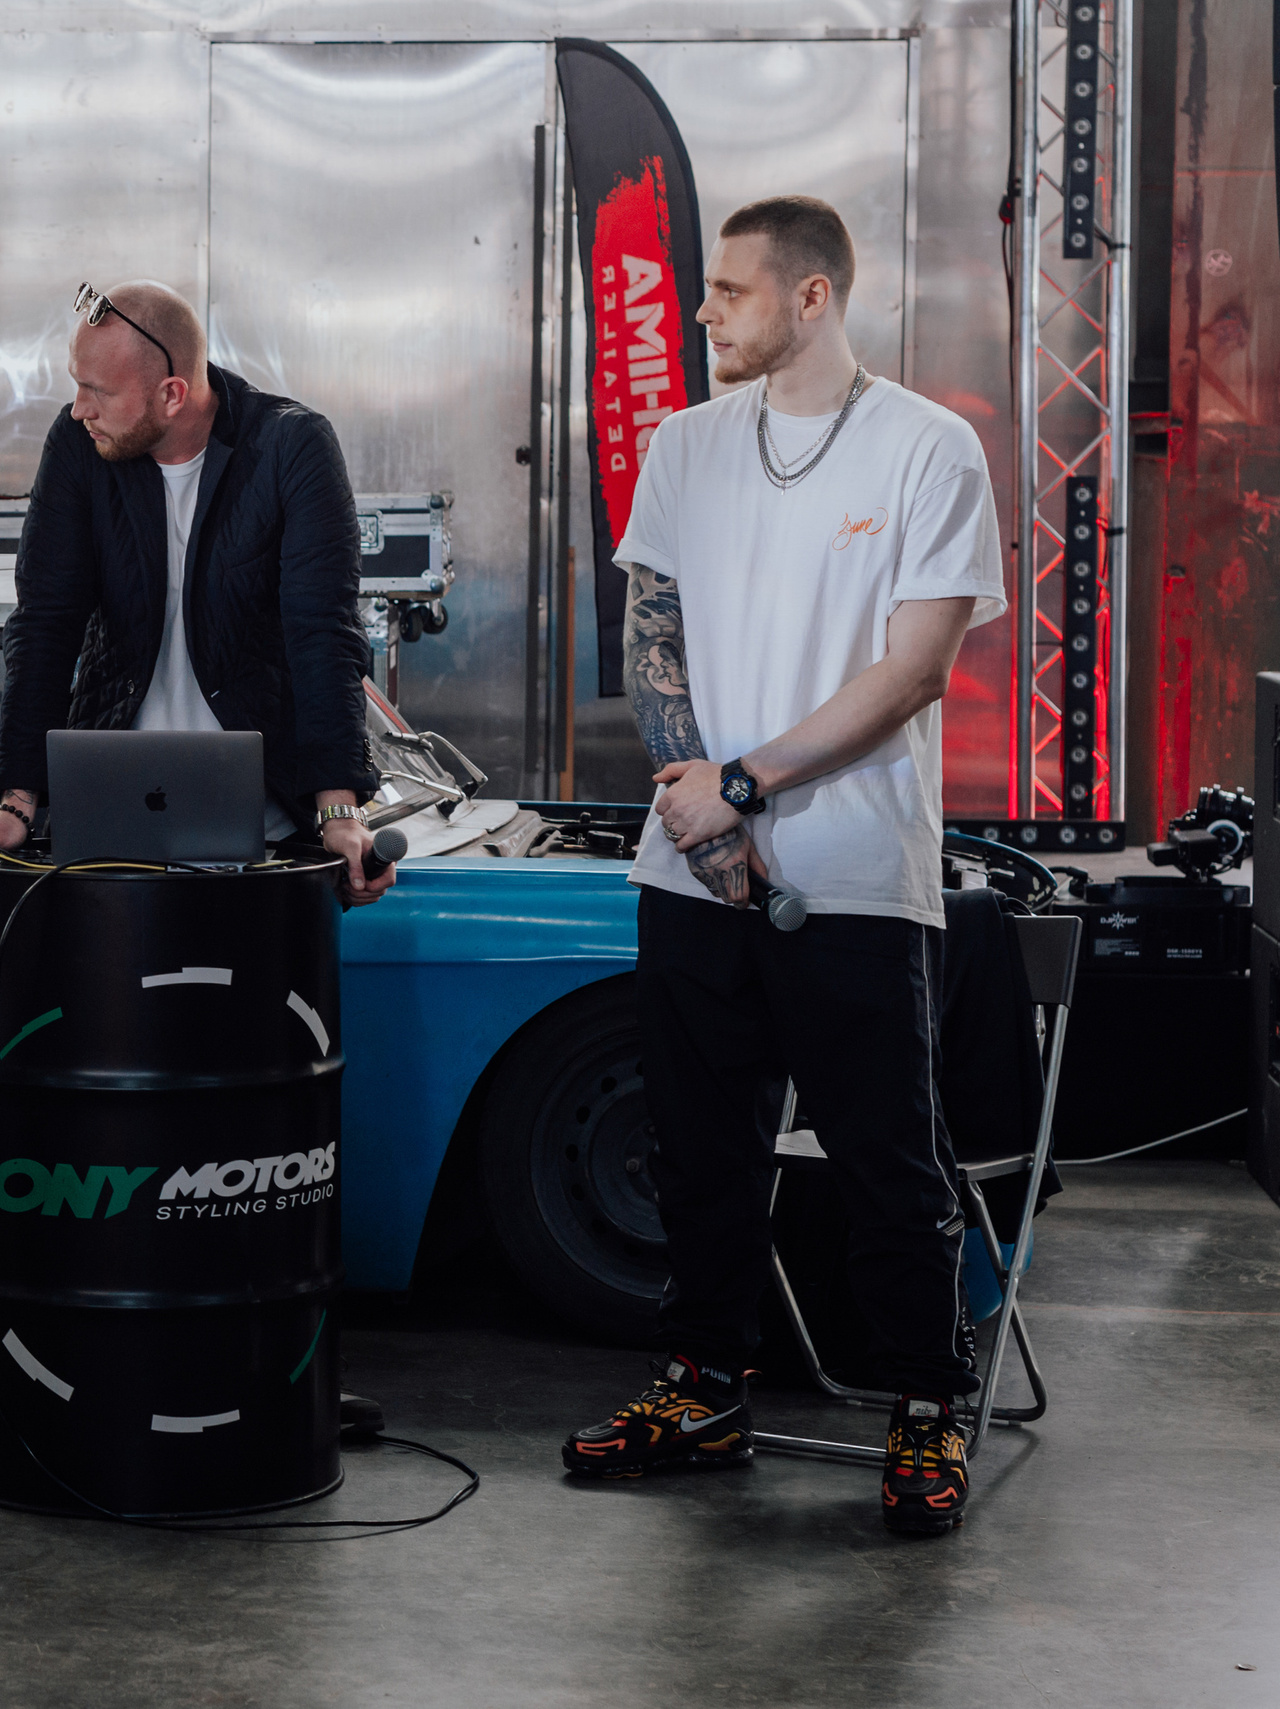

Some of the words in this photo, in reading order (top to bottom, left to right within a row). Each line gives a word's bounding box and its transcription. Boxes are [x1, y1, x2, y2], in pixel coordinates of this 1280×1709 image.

[158, 1141, 336, 1200] MOTORS
[156, 1199, 267, 1220] STYLING
[275, 1183, 334, 1211] STUDIO
